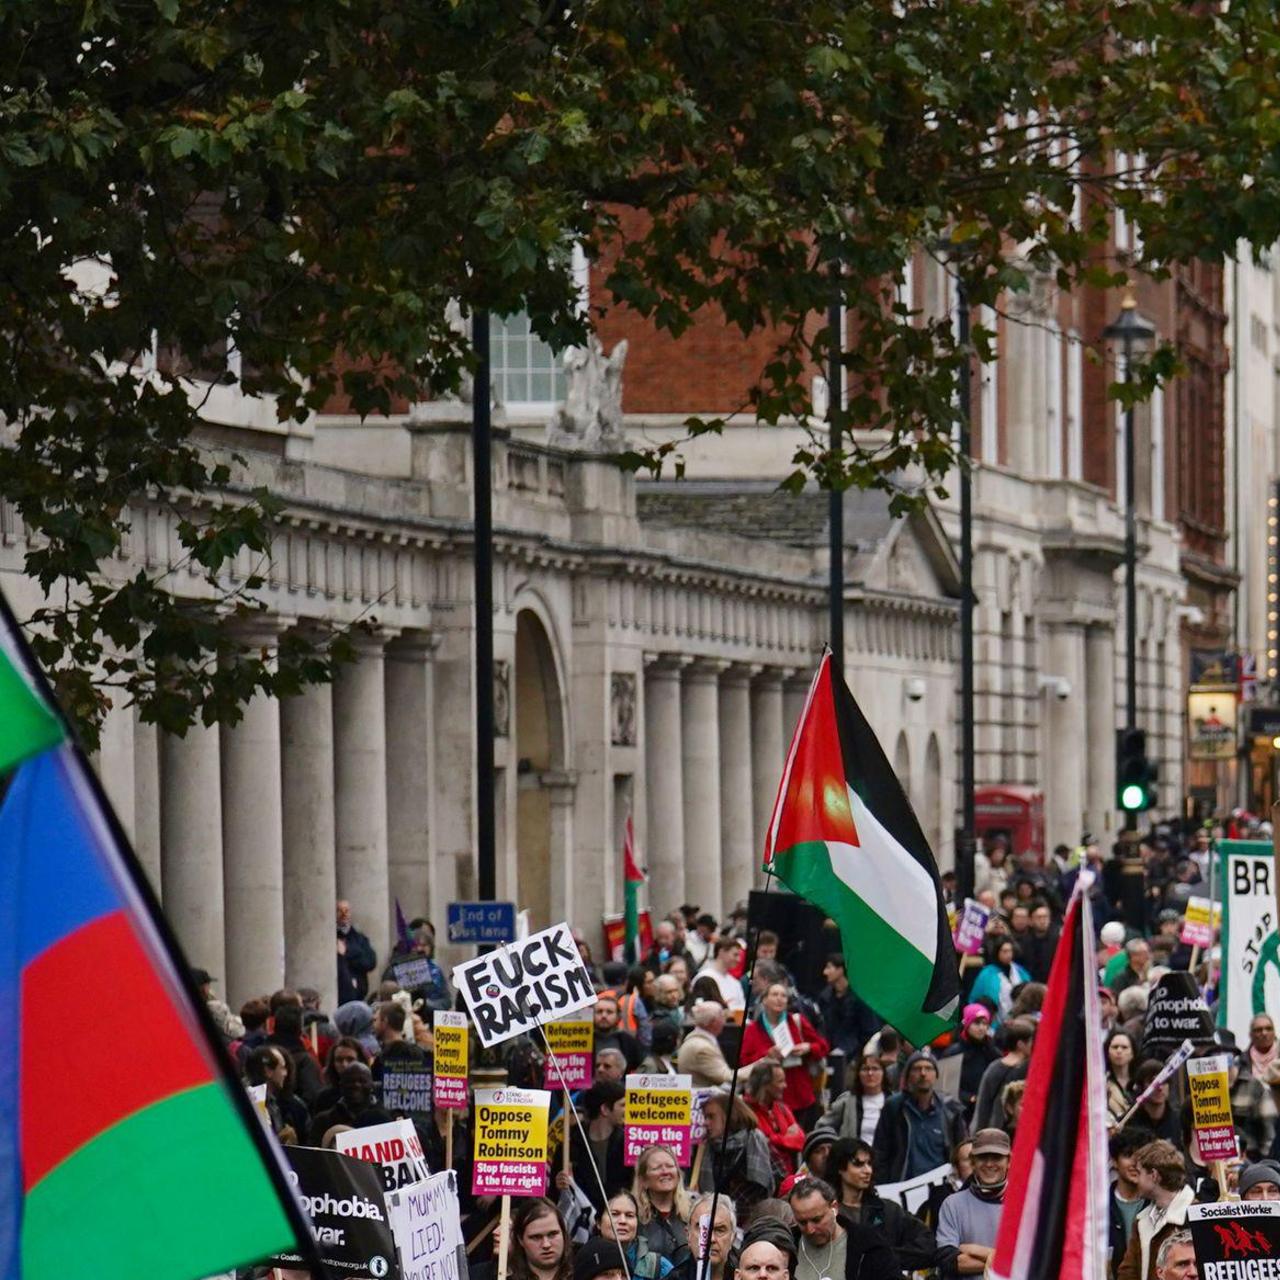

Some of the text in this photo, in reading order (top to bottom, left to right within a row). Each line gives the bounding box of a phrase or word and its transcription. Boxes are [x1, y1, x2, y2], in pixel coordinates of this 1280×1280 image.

[464, 929, 574, 1003] FUCK
[472, 965, 596, 1041] RACISM
[629, 1092, 688, 1107] Refugees
[479, 1108, 532, 1125] Oppose
[629, 1109, 686, 1120] welcome
[479, 1126, 530, 1143] Tommy
[478, 1143, 544, 1159] Robinson
[408, 1188, 447, 1219] MUMMY
[411, 1222, 446, 1261] LIED!
